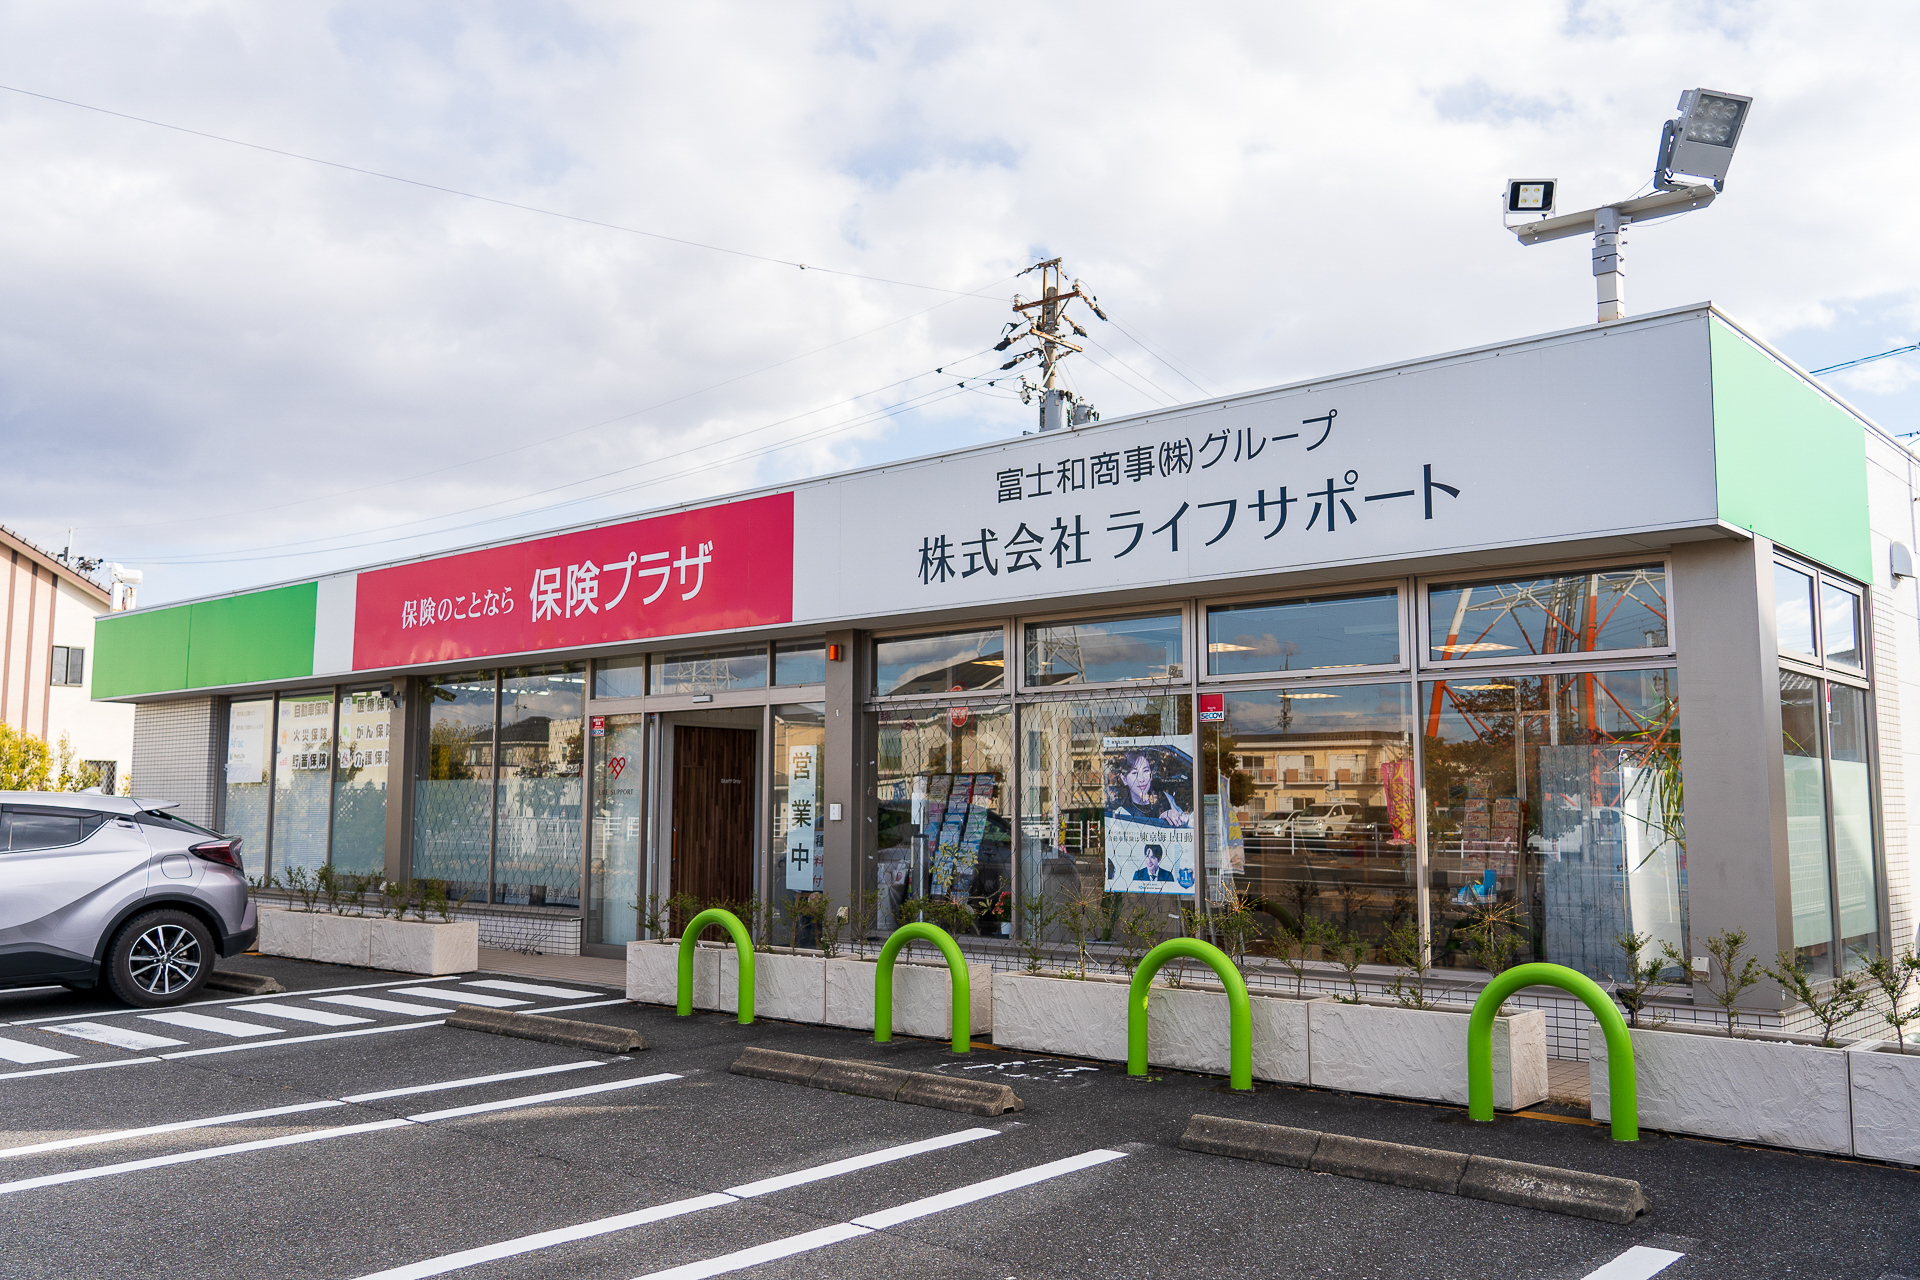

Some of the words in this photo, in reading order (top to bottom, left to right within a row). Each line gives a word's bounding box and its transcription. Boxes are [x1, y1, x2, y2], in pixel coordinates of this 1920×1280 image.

[918, 513, 1091, 585] 株式会社
[1106, 463, 1461, 559] ライフサポート
[401, 586, 515, 629] 保険のことなら
[530, 540, 714, 623] 保険プラザ
[294, 702, 328, 718] 自動車保険
[1201, 711, 1223, 720] SECOM
[293, 727, 328, 742] 火災保険
[291, 753, 327, 769] 貯蓄保険
[791, 752, 811, 871] 営業中
